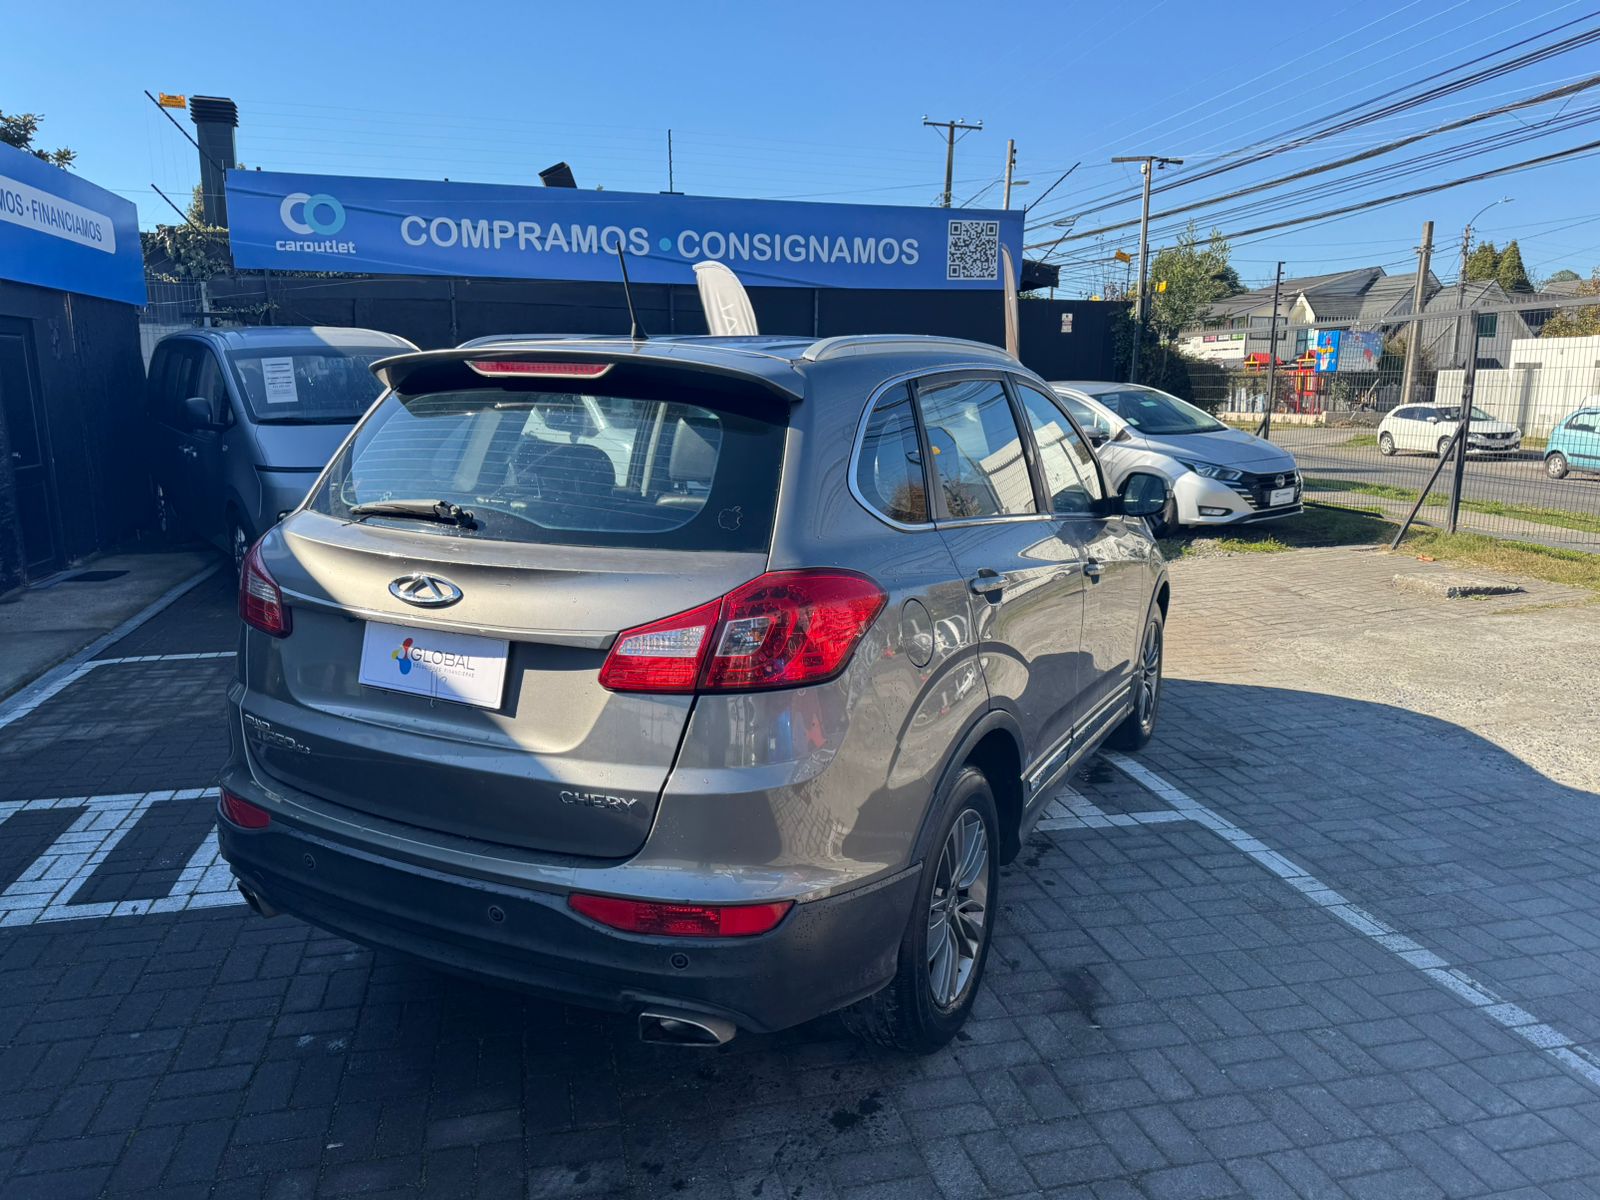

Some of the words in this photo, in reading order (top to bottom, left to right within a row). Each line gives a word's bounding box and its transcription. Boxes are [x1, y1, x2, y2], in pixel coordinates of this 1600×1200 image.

[31, 199, 103, 242] FINANCIAMOS
[275, 240, 357, 254] caroutlet
[401, 215, 650, 256] COMPRAMOS
[677, 230, 920, 265] CONSIGNAMOS
[410, 647, 475, 671] GLOBAL
[560, 790, 638, 811] CHERY
